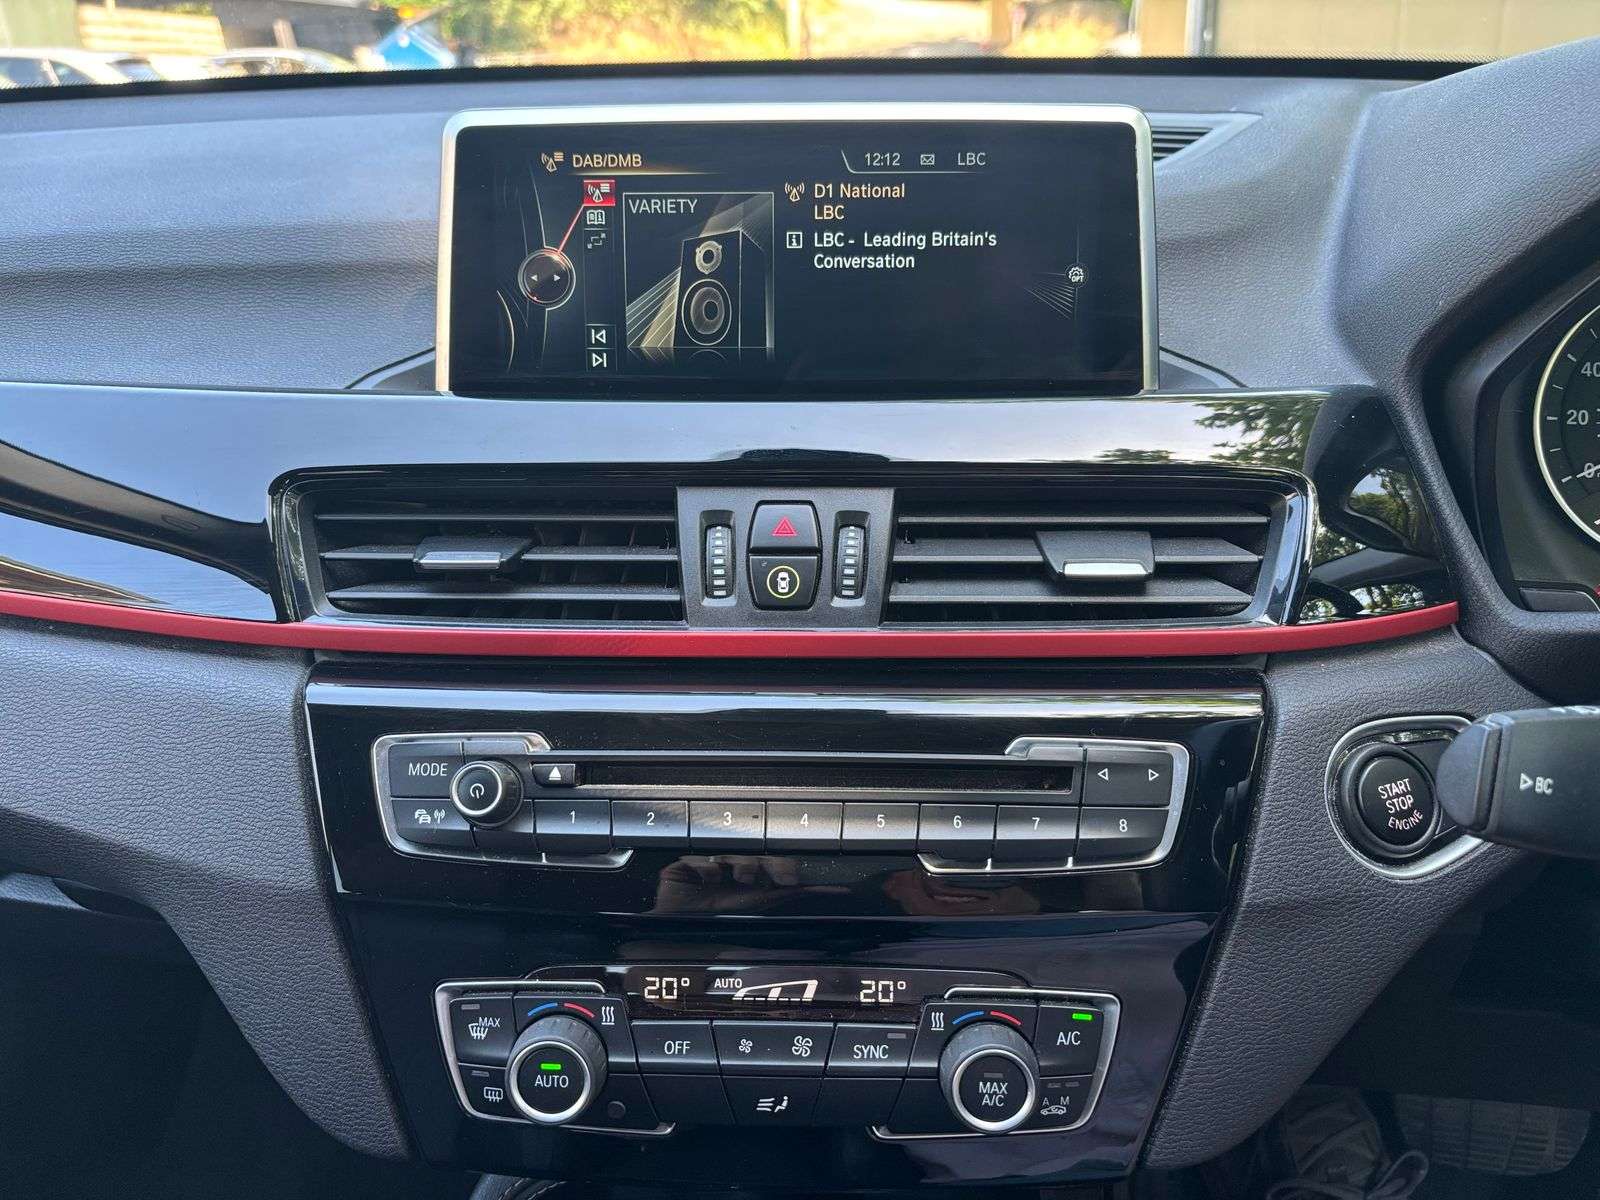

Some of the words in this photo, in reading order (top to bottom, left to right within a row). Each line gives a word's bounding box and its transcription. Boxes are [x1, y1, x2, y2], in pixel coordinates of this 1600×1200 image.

[572, 153, 643, 168] DAB/DMB
[864, 153, 901, 166] 12:12
[957, 152, 987, 166] LBC
[813, 183, 833, 199] D1
[839, 182, 906, 199] National
[628, 199, 698, 214] VARIETY
[813, 205, 845, 220] LBC
[813, 232, 845, 248] LBC
[863, 231, 927, 250] Leading
[931, 231, 998, 247] Britain's
[813, 253, 916, 269] Conversation
[1566, 409, 1589, 425] 20
[408, 762, 448, 777] MODE
[1377, 778, 1411, 800] START
[1534, 776, 1554, 795] BC
[1385, 794, 1415, 814] STOP
[569, 810, 577, 824] 1
[646, 812, 656, 826] 2
[723, 811, 732, 826] 3
[800, 813, 809, 828] 4
[876, 814, 886, 828] 5
[953, 815, 962, 829] 6
[1031, 817, 1041, 831] 7
[1387, 809, 1424, 831] ENGINE
[1118, 818, 1128, 832] 8
[713, 978, 743, 989] AUTO
[478, 1016, 501, 1028] MAX
[1056, 1031, 1081, 1046] A/C
[664, 1040, 691, 1055] OFF
[853, 1044, 889, 1060] SYNC
[534, 1074, 569, 1088] AUTO
[978, 1081, 1009, 1095] MAX
[981, 1094, 1005, 1107] A/C
